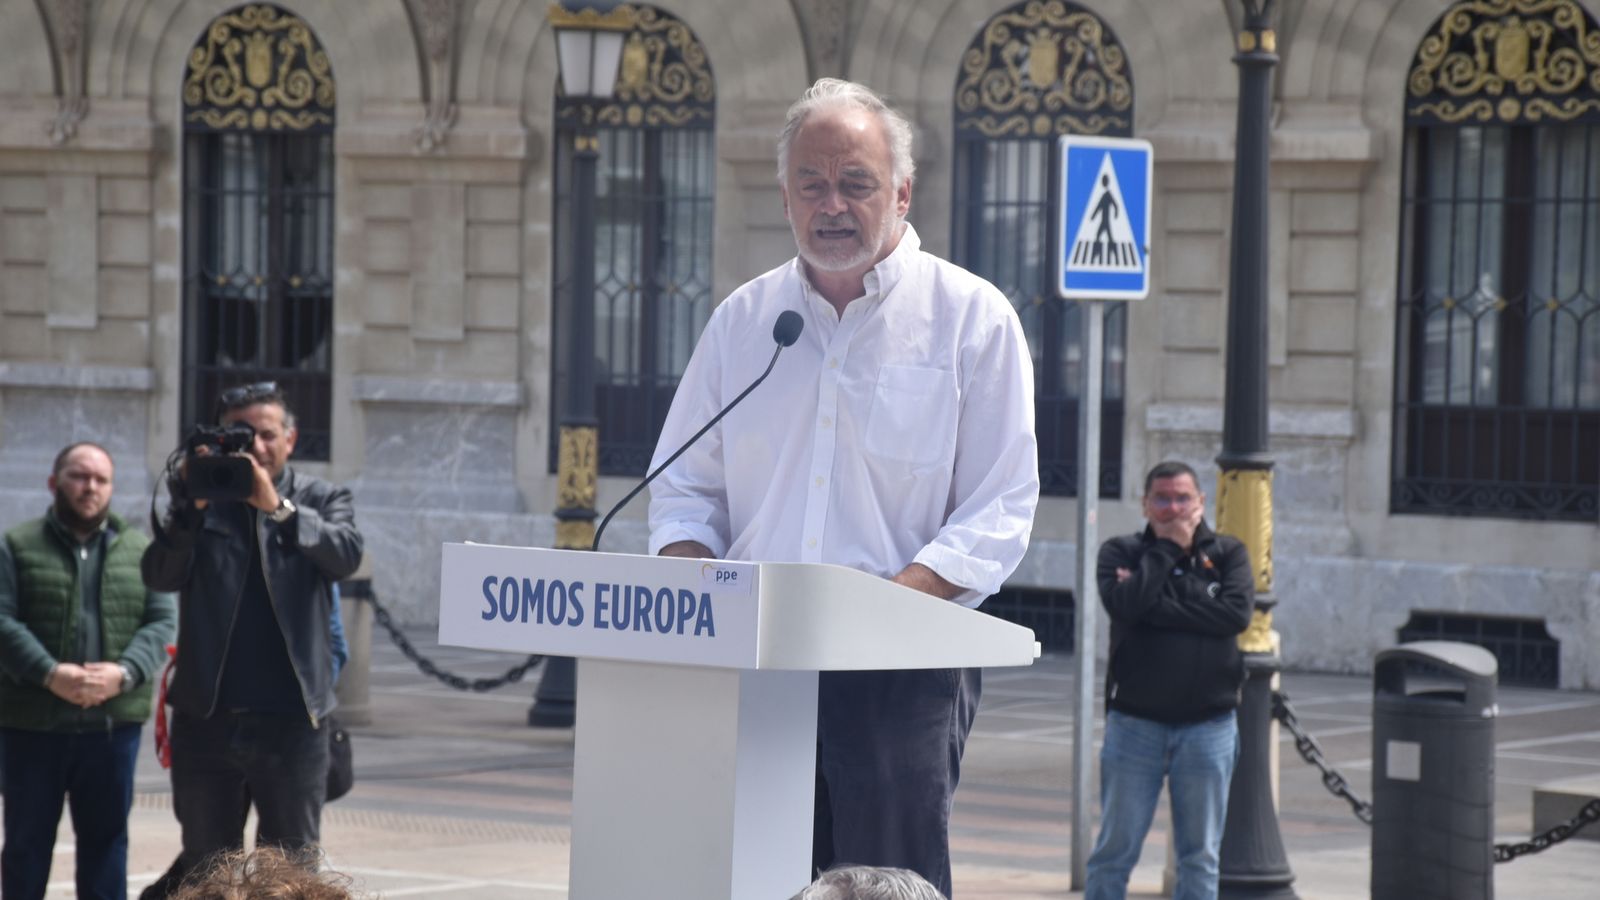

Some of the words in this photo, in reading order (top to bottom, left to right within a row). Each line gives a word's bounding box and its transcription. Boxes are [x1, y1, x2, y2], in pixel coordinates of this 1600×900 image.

[716, 570, 738, 583] ppe
[481, 575, 584, 627] SOMOS
[593, 583, 716, 637] EUROPA
